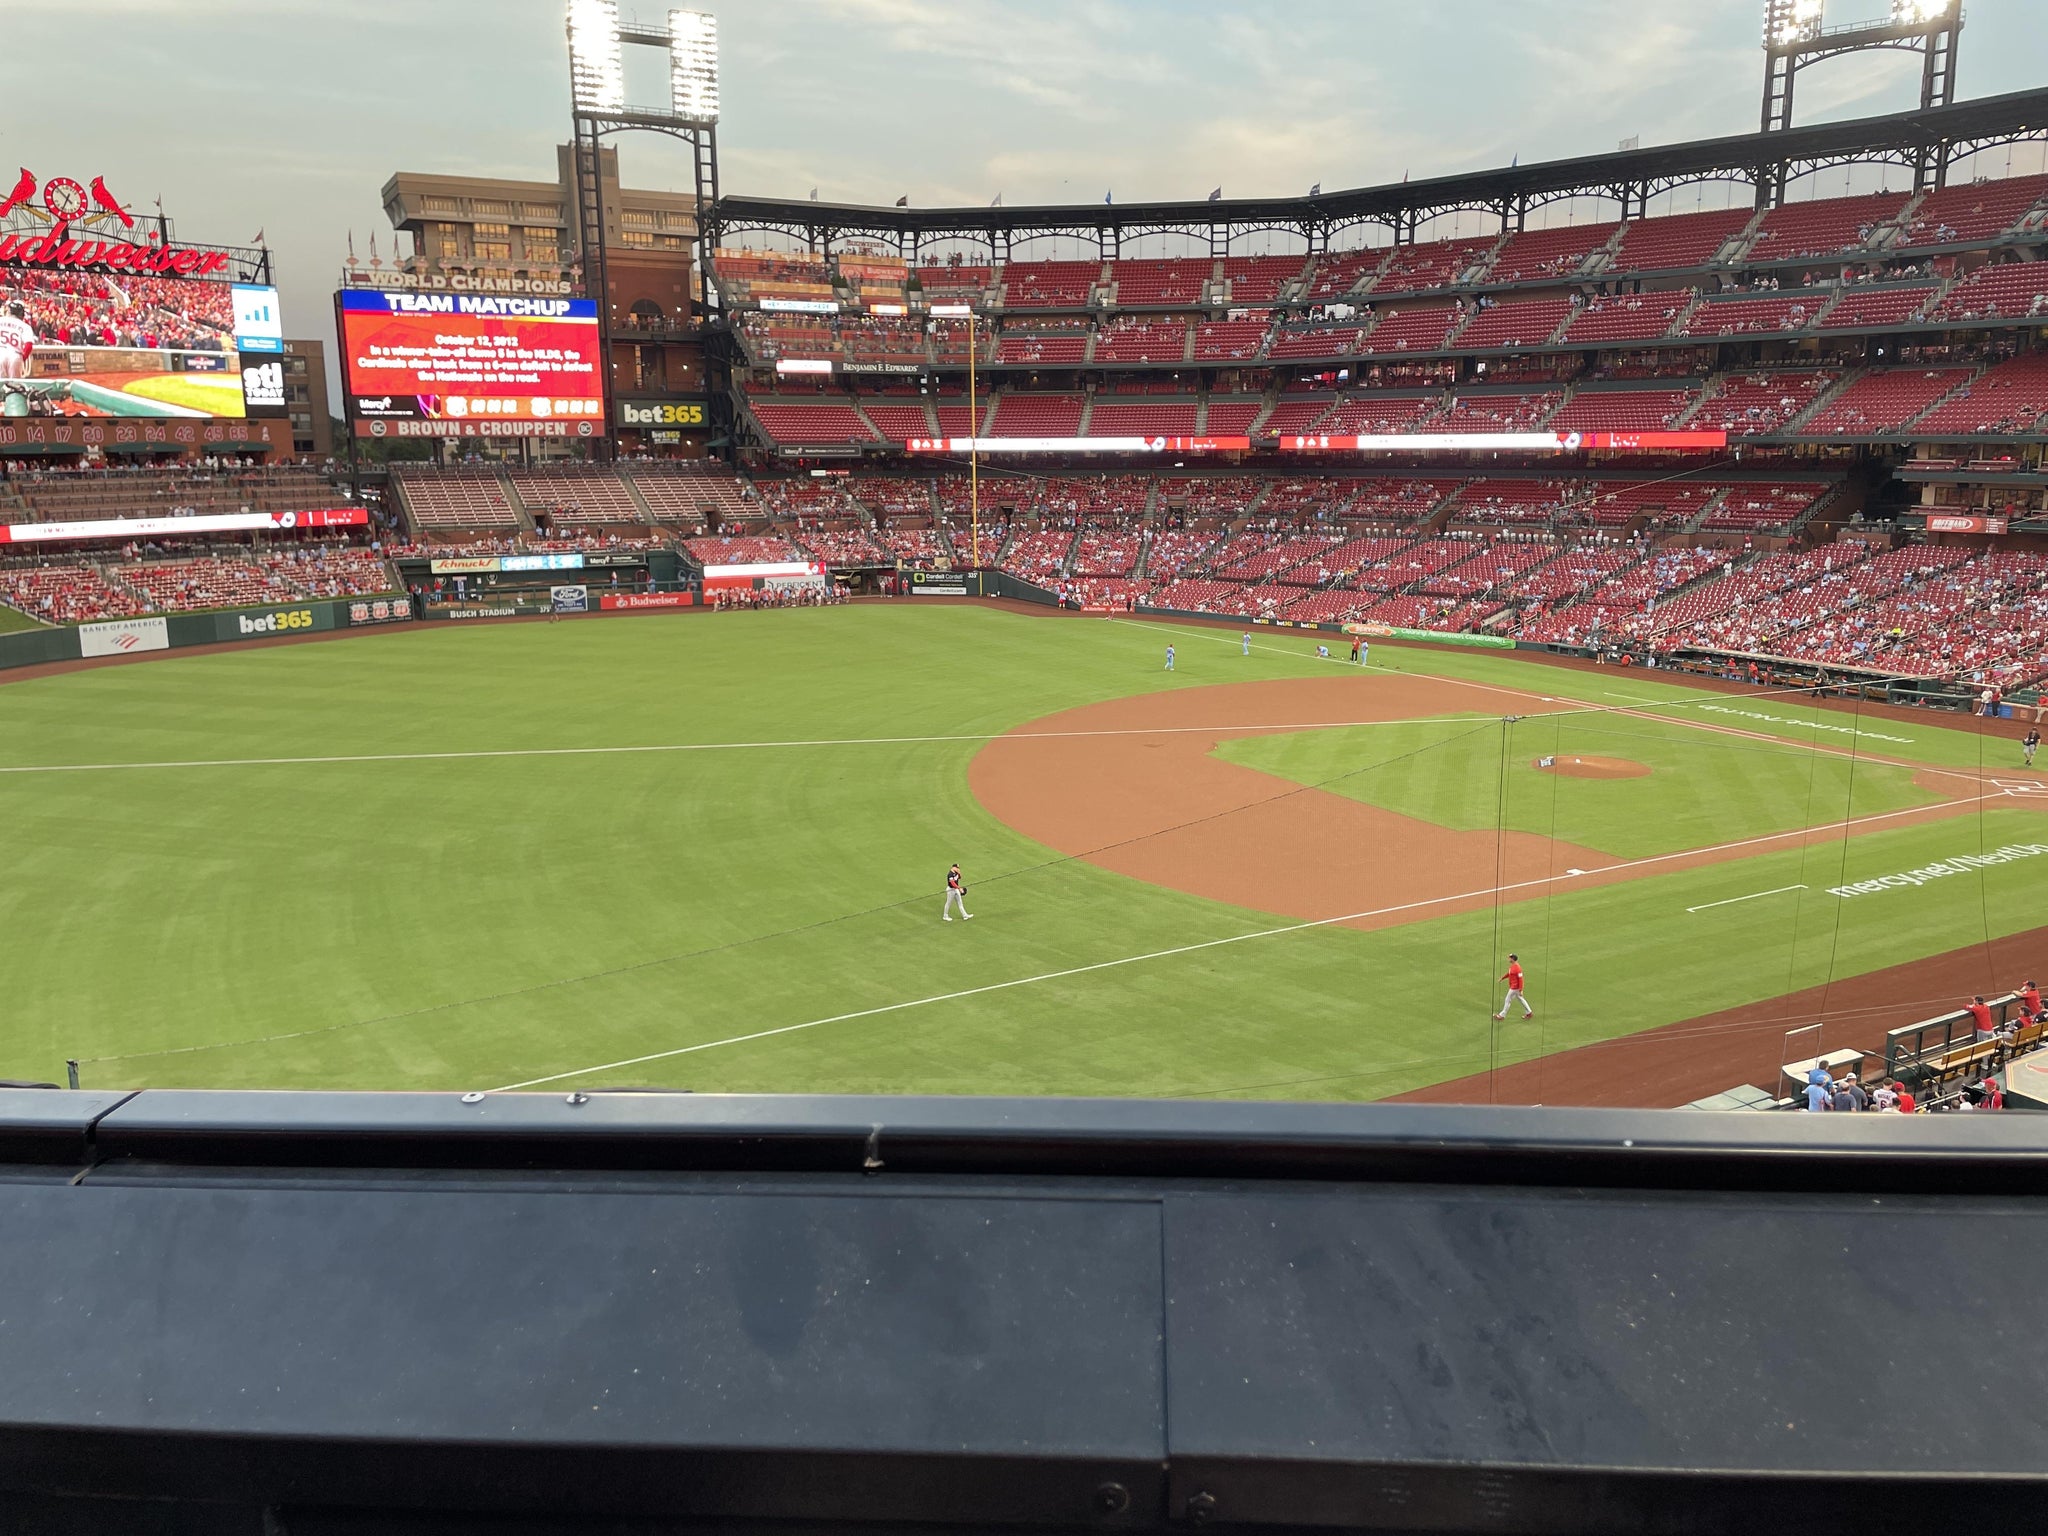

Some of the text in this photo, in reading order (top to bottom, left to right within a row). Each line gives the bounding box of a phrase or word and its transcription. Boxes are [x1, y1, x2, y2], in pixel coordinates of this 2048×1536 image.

[0, 221, 229, 275] udweiser
[368, 272, 572, 294] WORLD CHAMPIONS
[384, 293, 570, 316] TEAM MATCHUP
[435, 334, 518, 346] October 12, 2012
[842, 362, 877, 372] BENJAMIN
[885, 364, 918, 372] EDWARDS
[245, 387, 283, 398] TODAY
[623, 403, 703, 423] bet365
[26, 426, 45, 442] 14
[55, 426, 72, 442] 17
[82, 426, 104, 442] 20
[116, 426, 137, 442] 23
[145, 426, 166, 442] 24
[174, 426, 195, 442] 42
[204, 426, 224, 442] 45
[397, 420, 566, 436] BROWN & CROUPPEN
[651, 430, 680, 439] bet365
[559, 590, 580, 598] Ford
[630, 595, 679, 606] Budweiser
[450, 607, 516, 619] BUSCH STADIUM
[82, 619, 164, 633] BANK OF AMERICA
[239, 610, 313, 634] bet365
[1465, 634, 1505, 644] Construction
